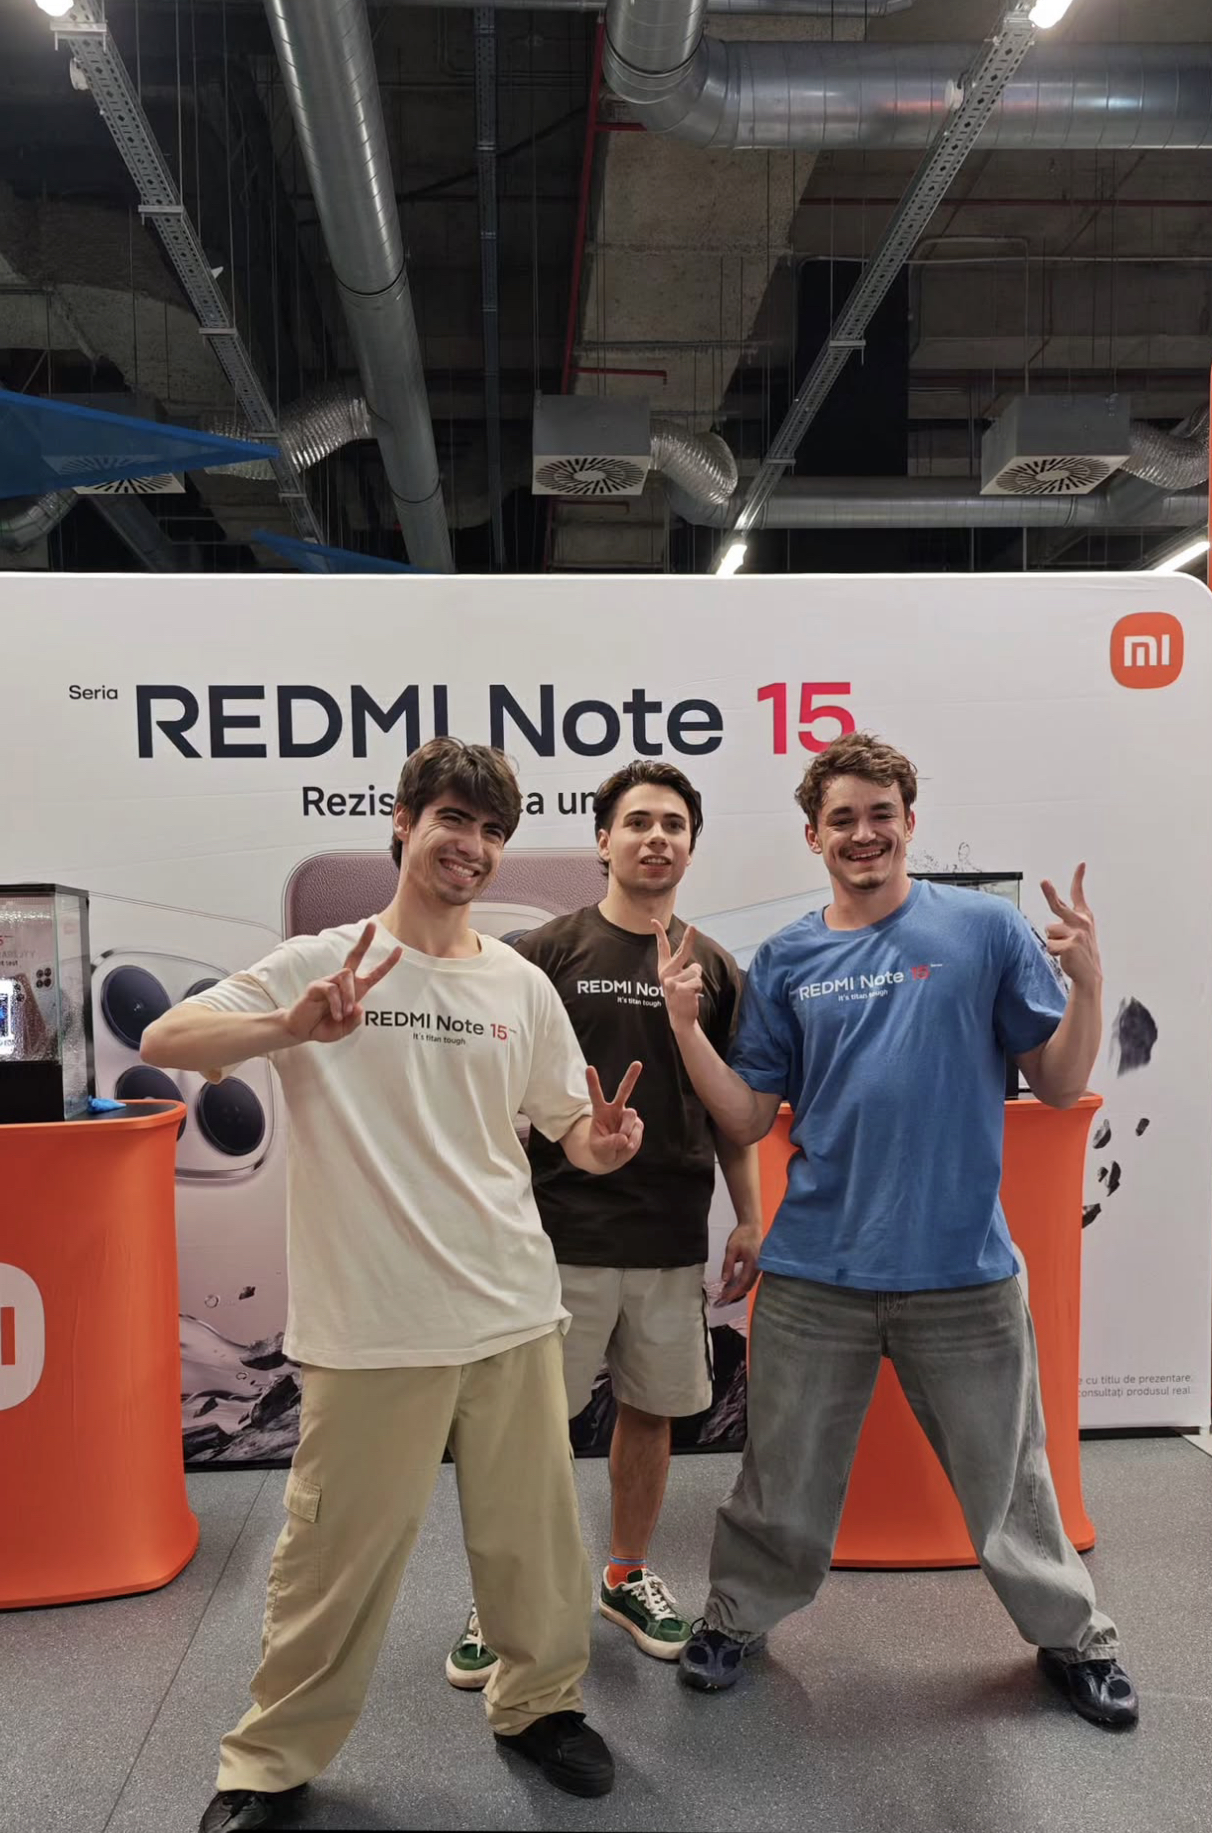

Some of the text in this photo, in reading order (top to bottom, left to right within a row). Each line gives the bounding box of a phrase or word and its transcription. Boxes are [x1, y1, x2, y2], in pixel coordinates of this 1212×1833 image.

[68, 681, 857, 759] Seria REDMI Note 15
[302, 785, 395, 816] Rezis
[577, 980, 665, 997] REDMI Not
[799, 965, 930, 1003] REDMI Note 15
[642, 999, 662, 1008] tough
[365, 1011, 508, 1041] REDMI Note 15
[413, 1033, 466, 1046] It's titan tough
[1085, 1377, 1098, 1385] cu
[1101, 1374, 1121, 1385] titlu
[1123, 1374, 1136, 1384] de
[1126, 1386, 1170, 1397] produsul
